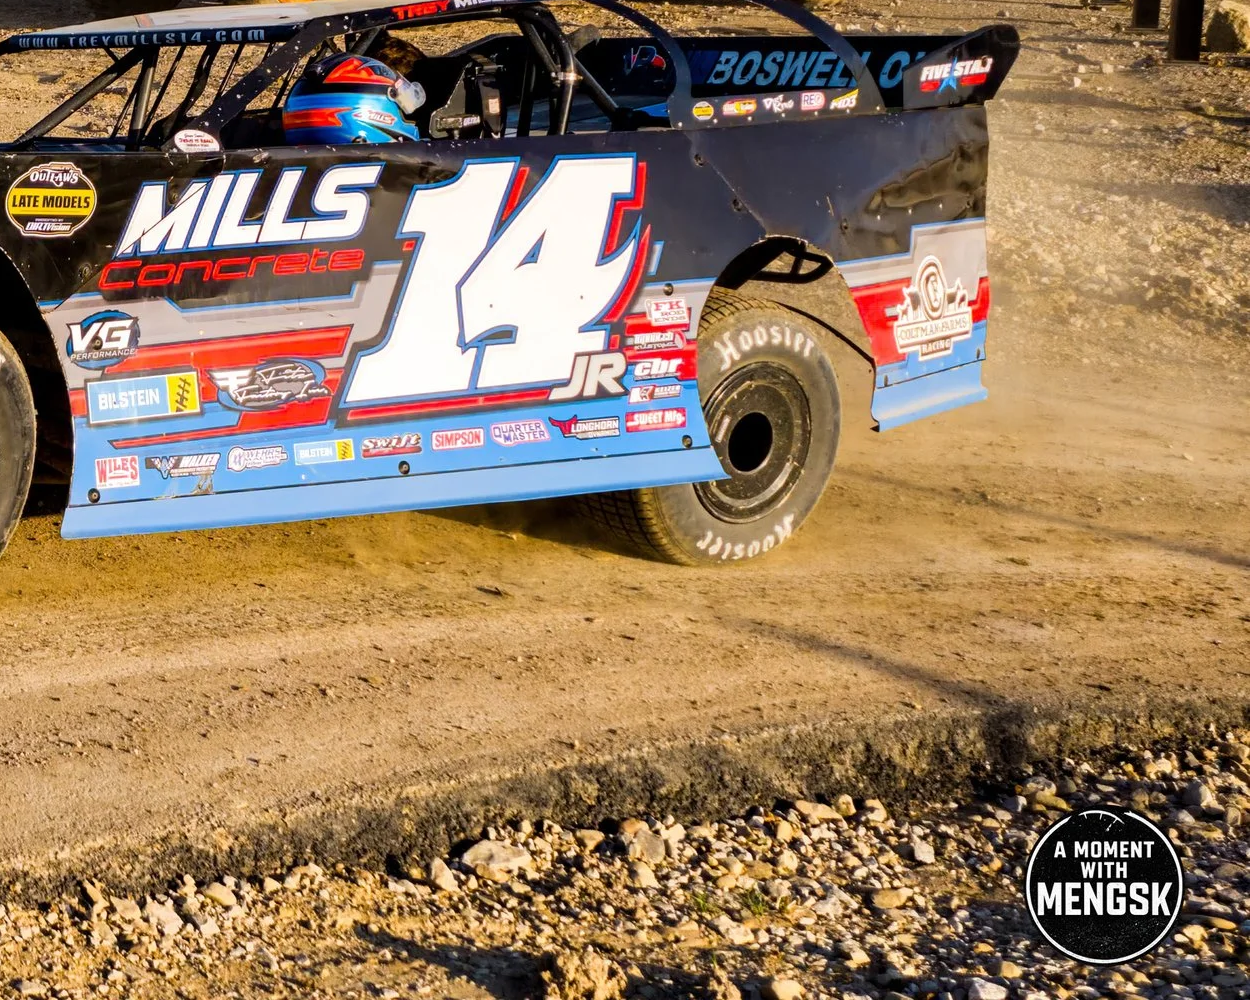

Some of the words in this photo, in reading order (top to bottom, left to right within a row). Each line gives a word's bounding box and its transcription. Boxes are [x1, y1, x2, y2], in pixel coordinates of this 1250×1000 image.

[392, 0, 450, 20] TREY
[12, 194, 41, 209] LATE
[42, 194, 91, 210] MODELS
[114, 162, 388, 260] MILLS
[98, 248, 365, 291] Concrete
[343, 152, 647, 404] 14
[69, 319, 135, 352] VG
[71, 347, 136, 361] PERFORMANCE
[549, 351, 627, 401] JR
[98, 388, 160, 410] BILSTEIN
[493, 422, 542, 438] QUARTER
[570, 419, 620, 432] LONGHORN
[434, 431, 482, 448] SIMPSON
[503, 431, 547, 443] MASTER
[96, 456, 139, 483] WILES
